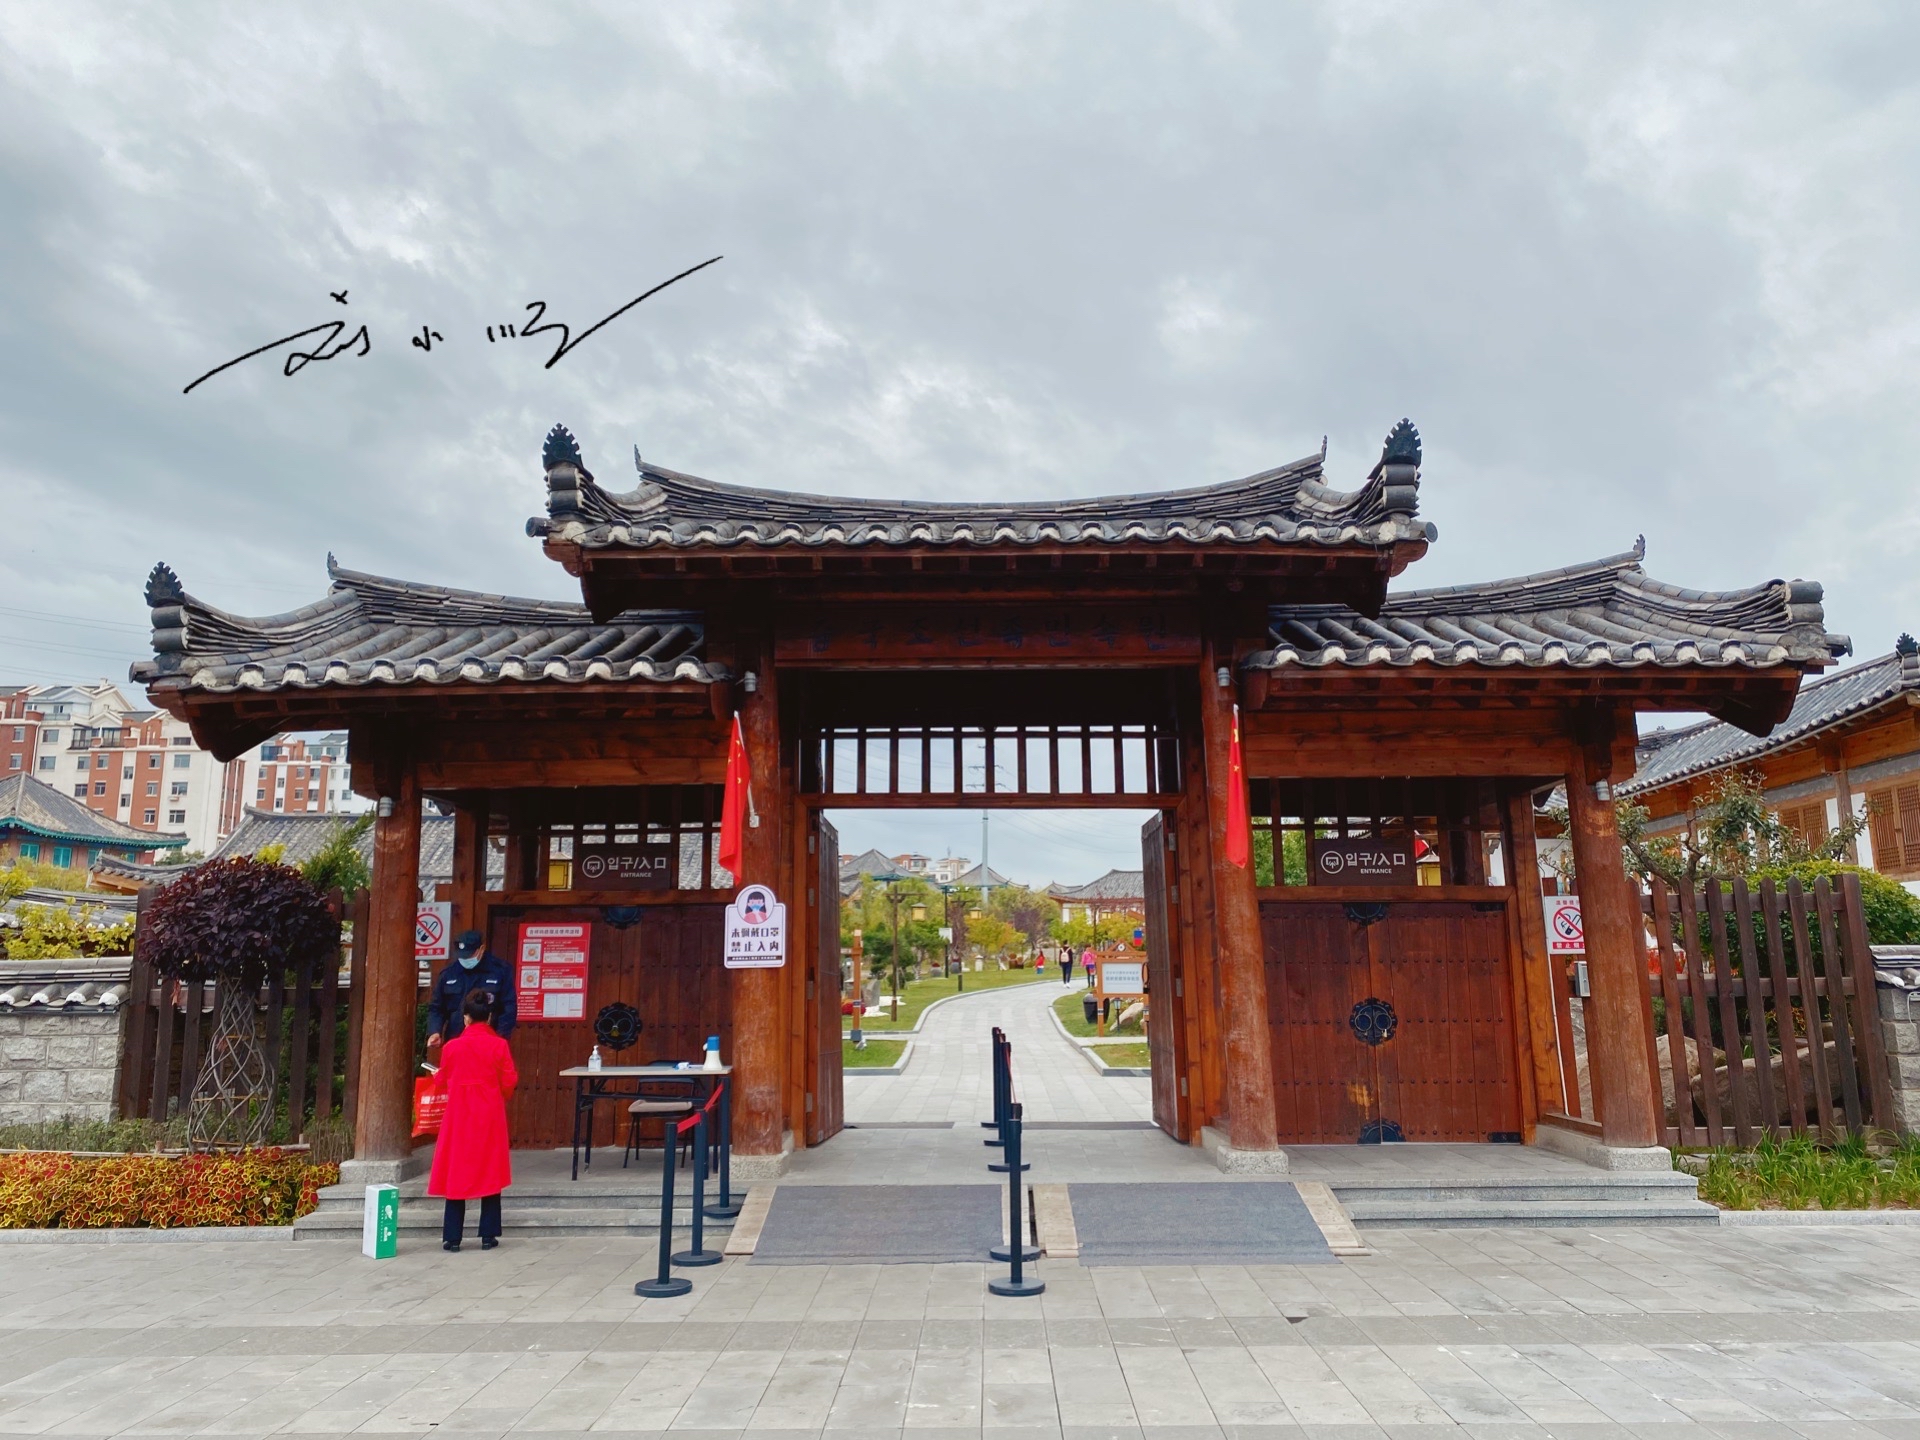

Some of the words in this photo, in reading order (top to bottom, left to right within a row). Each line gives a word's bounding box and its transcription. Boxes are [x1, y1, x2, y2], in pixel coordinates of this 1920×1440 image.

[731, 927, 779, 938] 未佩戴口罩
[731, 940, 779, 952] 禁止入内
